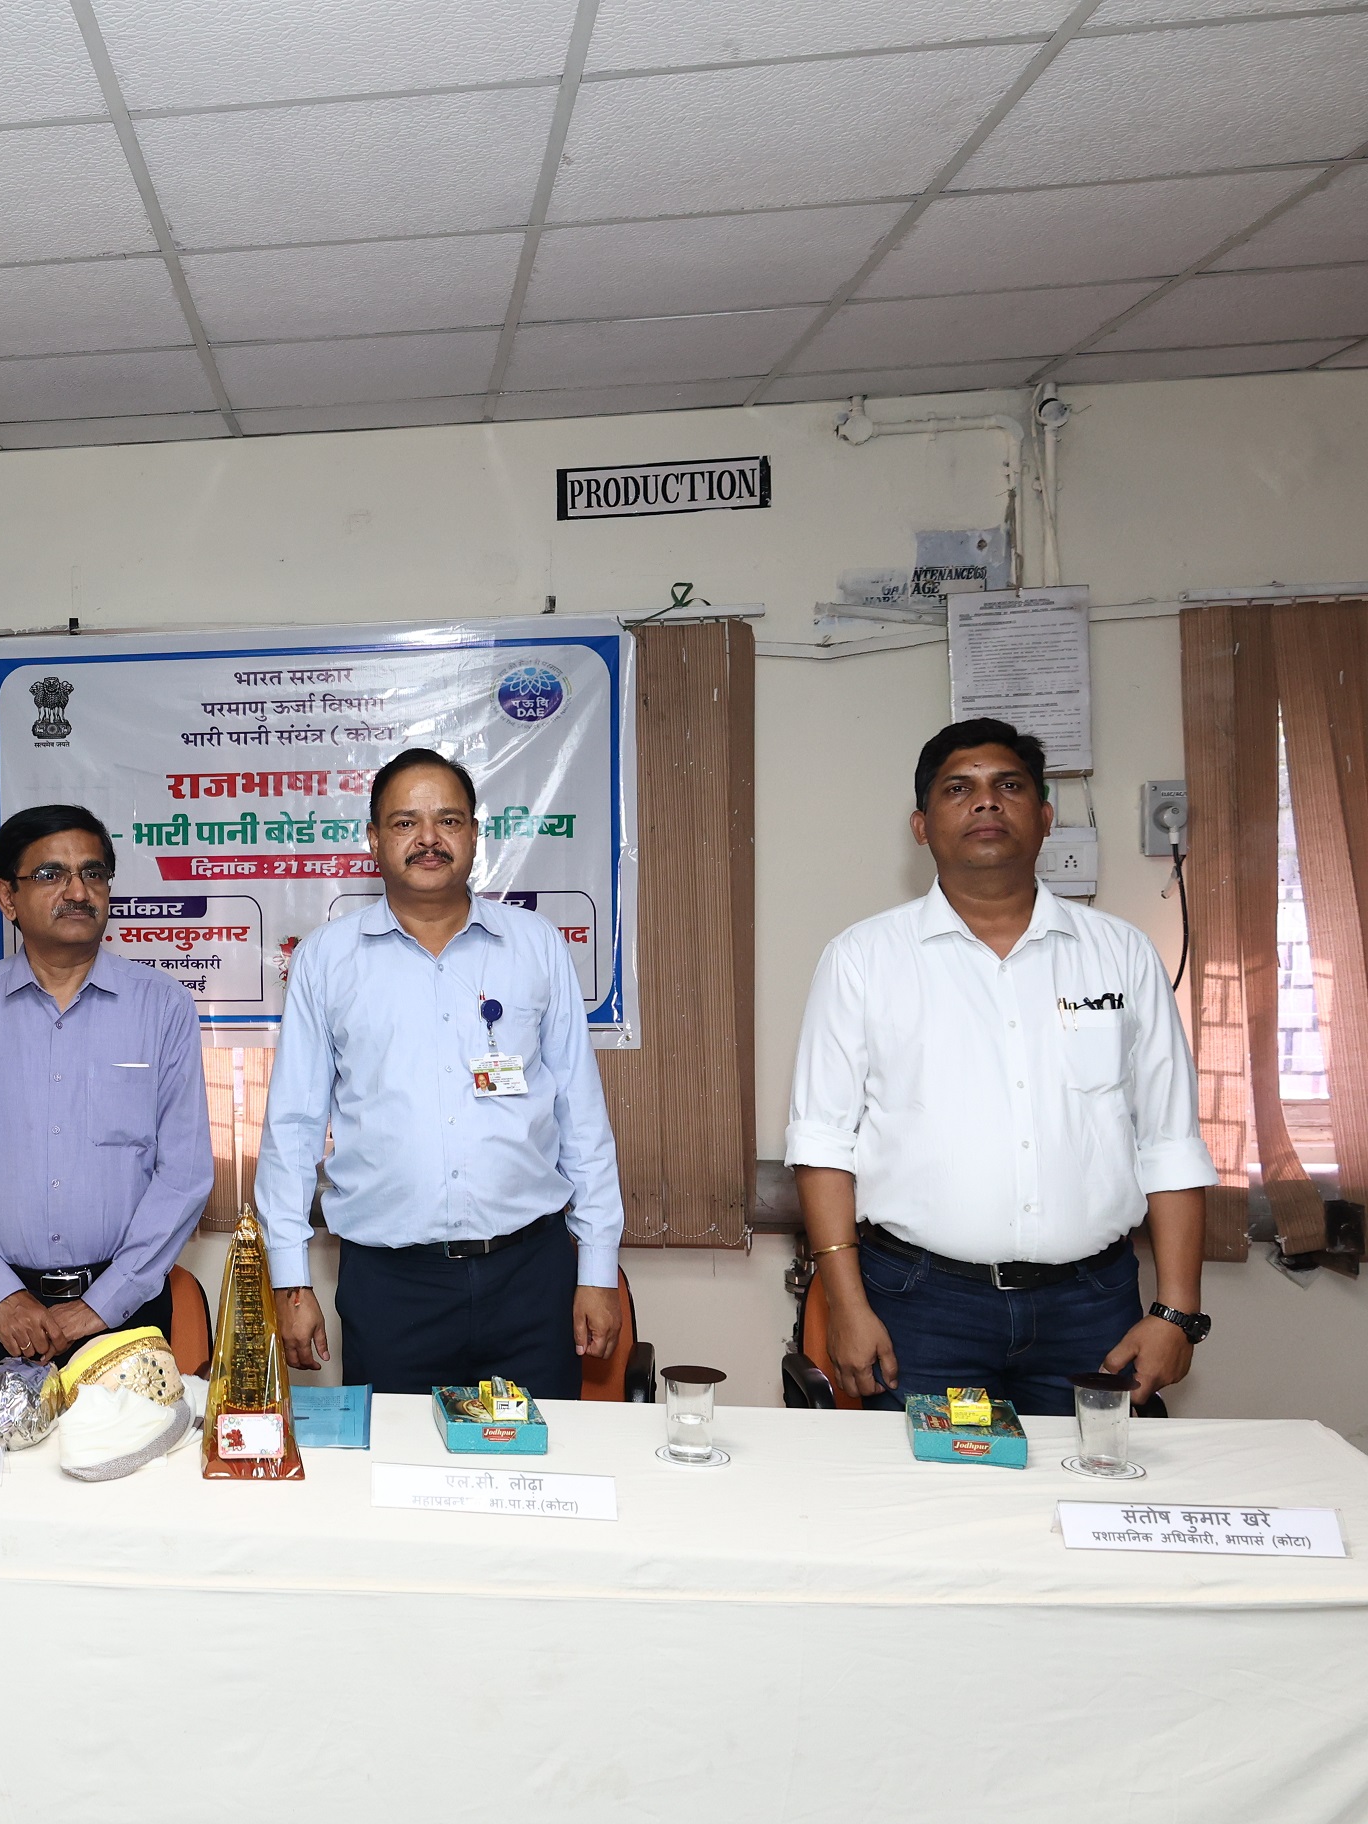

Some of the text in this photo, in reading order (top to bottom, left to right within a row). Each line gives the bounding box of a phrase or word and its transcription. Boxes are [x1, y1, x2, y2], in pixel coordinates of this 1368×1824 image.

[568, 467, 758, 510] PRODUCTION
[233, 668, 353, 687] भारत सरकार
[201, 693, 386, 722] परमाणु ऊर्जा विभाग
[517, 708, 545, 717] DAE
[180, 725, 223, 747] भारी
[227, 725, 272, 747] पानी
[275, 723, 326, 746] संयंत्र
[344, 720, 396, 743] कोटा
[165, 770, 331, 800] राजभाषा
[132, 813, 192, 847] भारी
[195, 811, 260, 846] पानी
[264, 810, 317, 845] बोर्ड
[320, 818, 362, 843] का
[190, 858, 258, 878] दिनांक
[303, 856, 344, 877] मई,
[119, 926, 251, 951] सत्यकुमार
[159, 954, 223, 970] कार्यकारी
[484, 1428, 515, 1438] Jodhpur
[954, 1441, 989, 1451] Jodhpur
[445, 1471, 499, 1490] एल.सी.
[411, 1494, 474, 1507] महाप्रबन्ध
[1120, 1504, 1272, 1533] संतोष कुमार खरे
[1092, 1528, 1312, 1550] प्रशासनिक अधिकारी, भापासं (कोटा)
